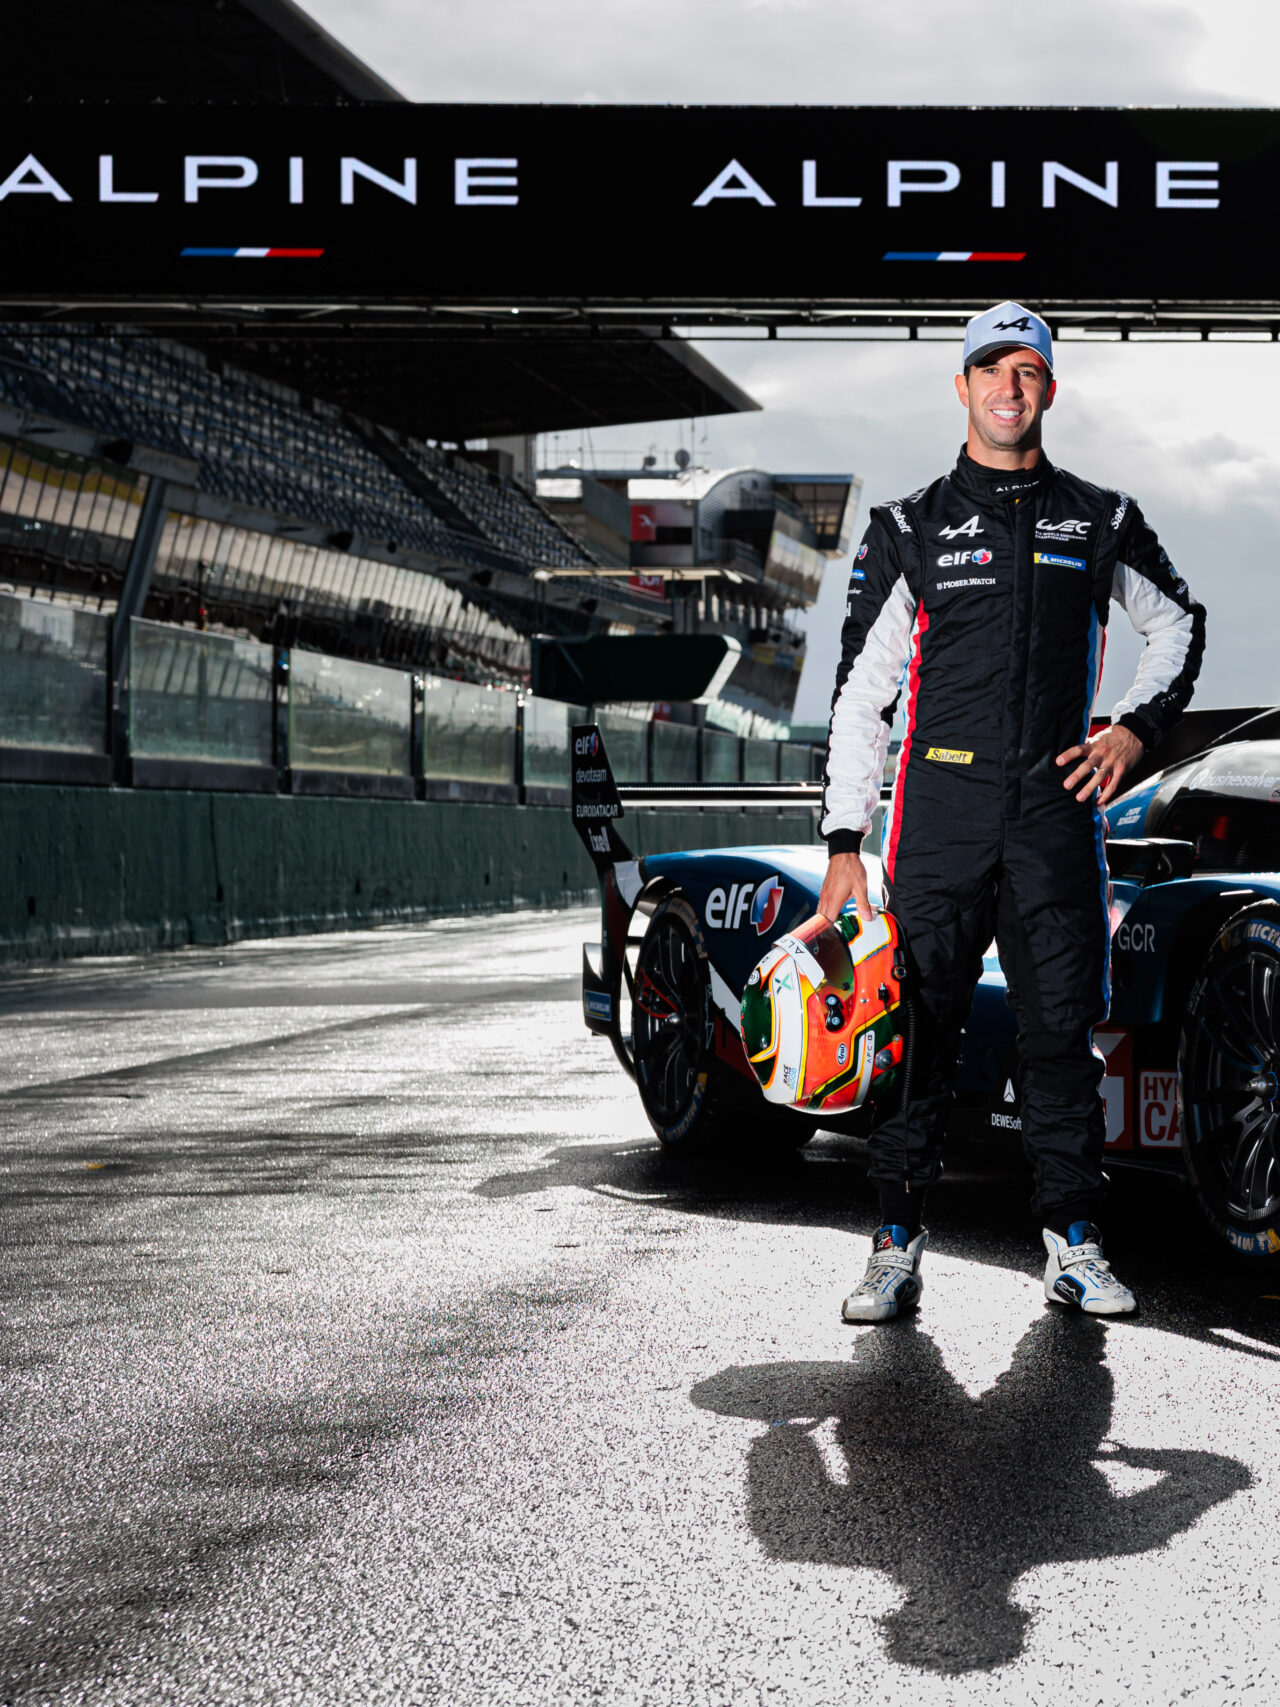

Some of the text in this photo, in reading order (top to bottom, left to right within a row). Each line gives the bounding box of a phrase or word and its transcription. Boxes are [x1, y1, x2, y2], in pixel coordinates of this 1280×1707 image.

[0, 154, 519, 206] ALPINE
[692, 159, 1220, 210] ALPINE
[890, 505, 913, 534] Sabelt
[937, 551, 972, 567] elf
[1050, 557, 1083, 568] MICHELIN
[575, 735, 590, 755] elf
[931, 749, 968, 762] Sabelt
[575, 767, 607, 784] devoteam
[576, 804, 618, 818] EURODATACAR
[587, 825, 611, 853] ixell
[705, 882, 754, 929] elf
[1144, 1076, 1179, 1101] HY
[991, 1112, 1022, 1131] DEWESoft
